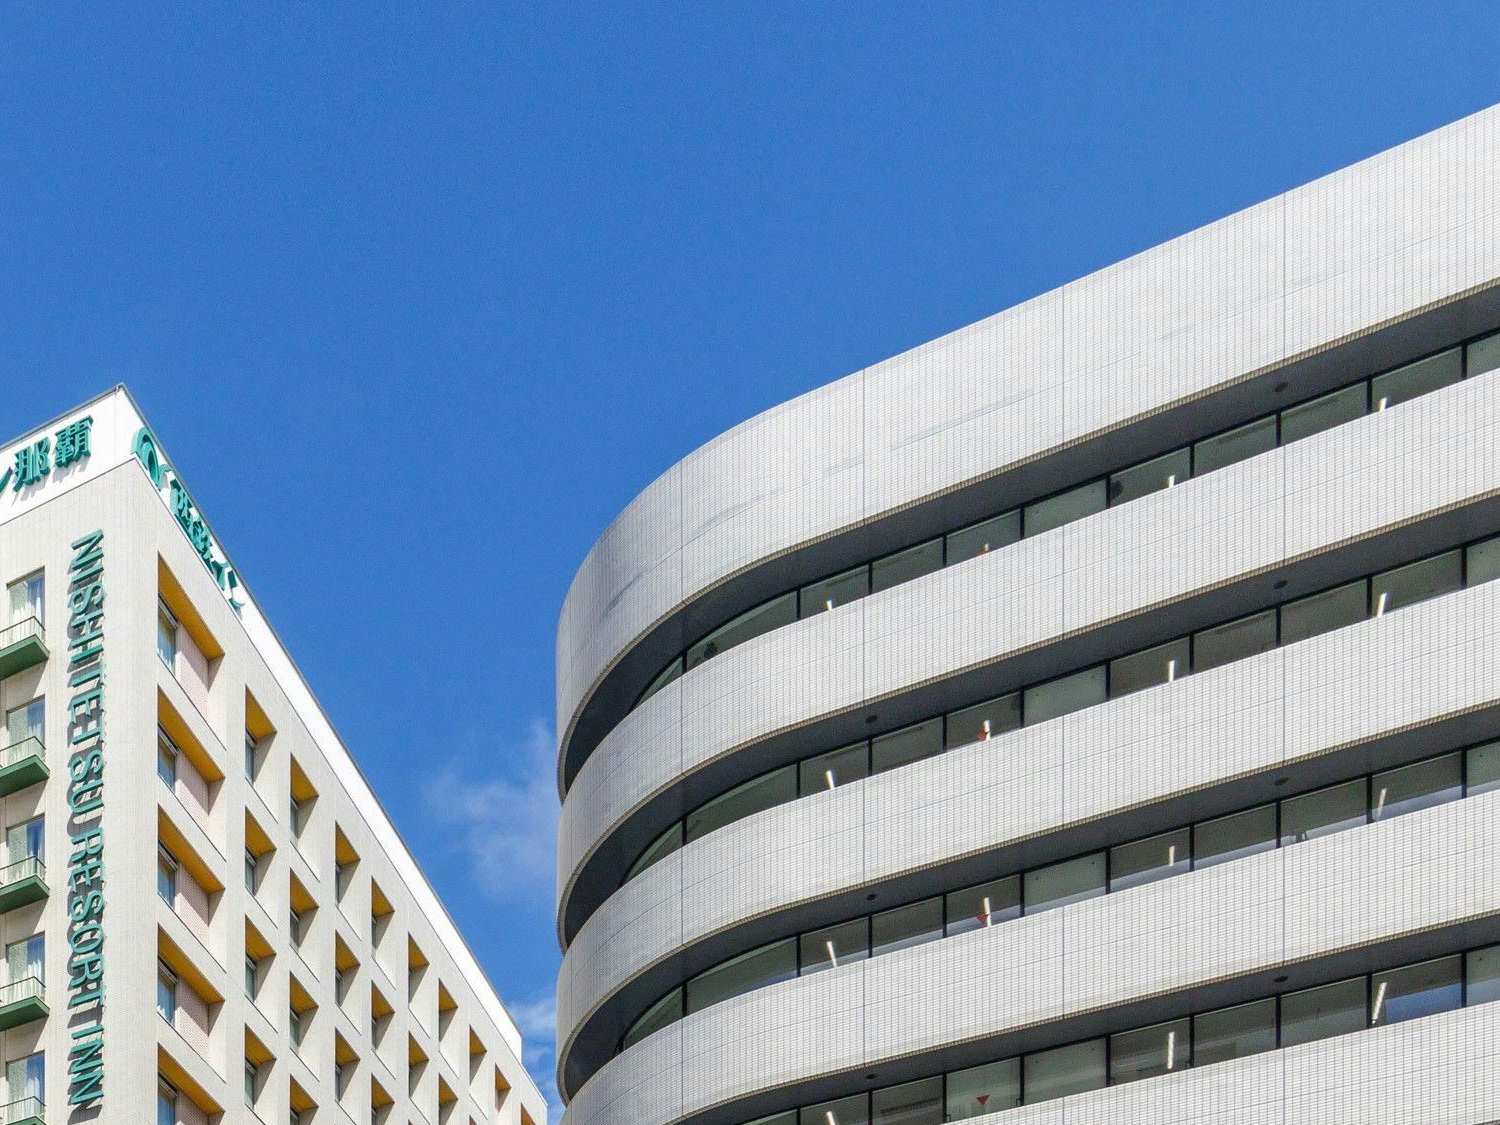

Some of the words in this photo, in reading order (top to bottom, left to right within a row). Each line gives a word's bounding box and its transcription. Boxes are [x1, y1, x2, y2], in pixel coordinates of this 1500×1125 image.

[69, 527, 106, 814] NISHITETSU
[69, 826, 106, 1009] RESORT
[70, 1023, 105, 1106] INN
